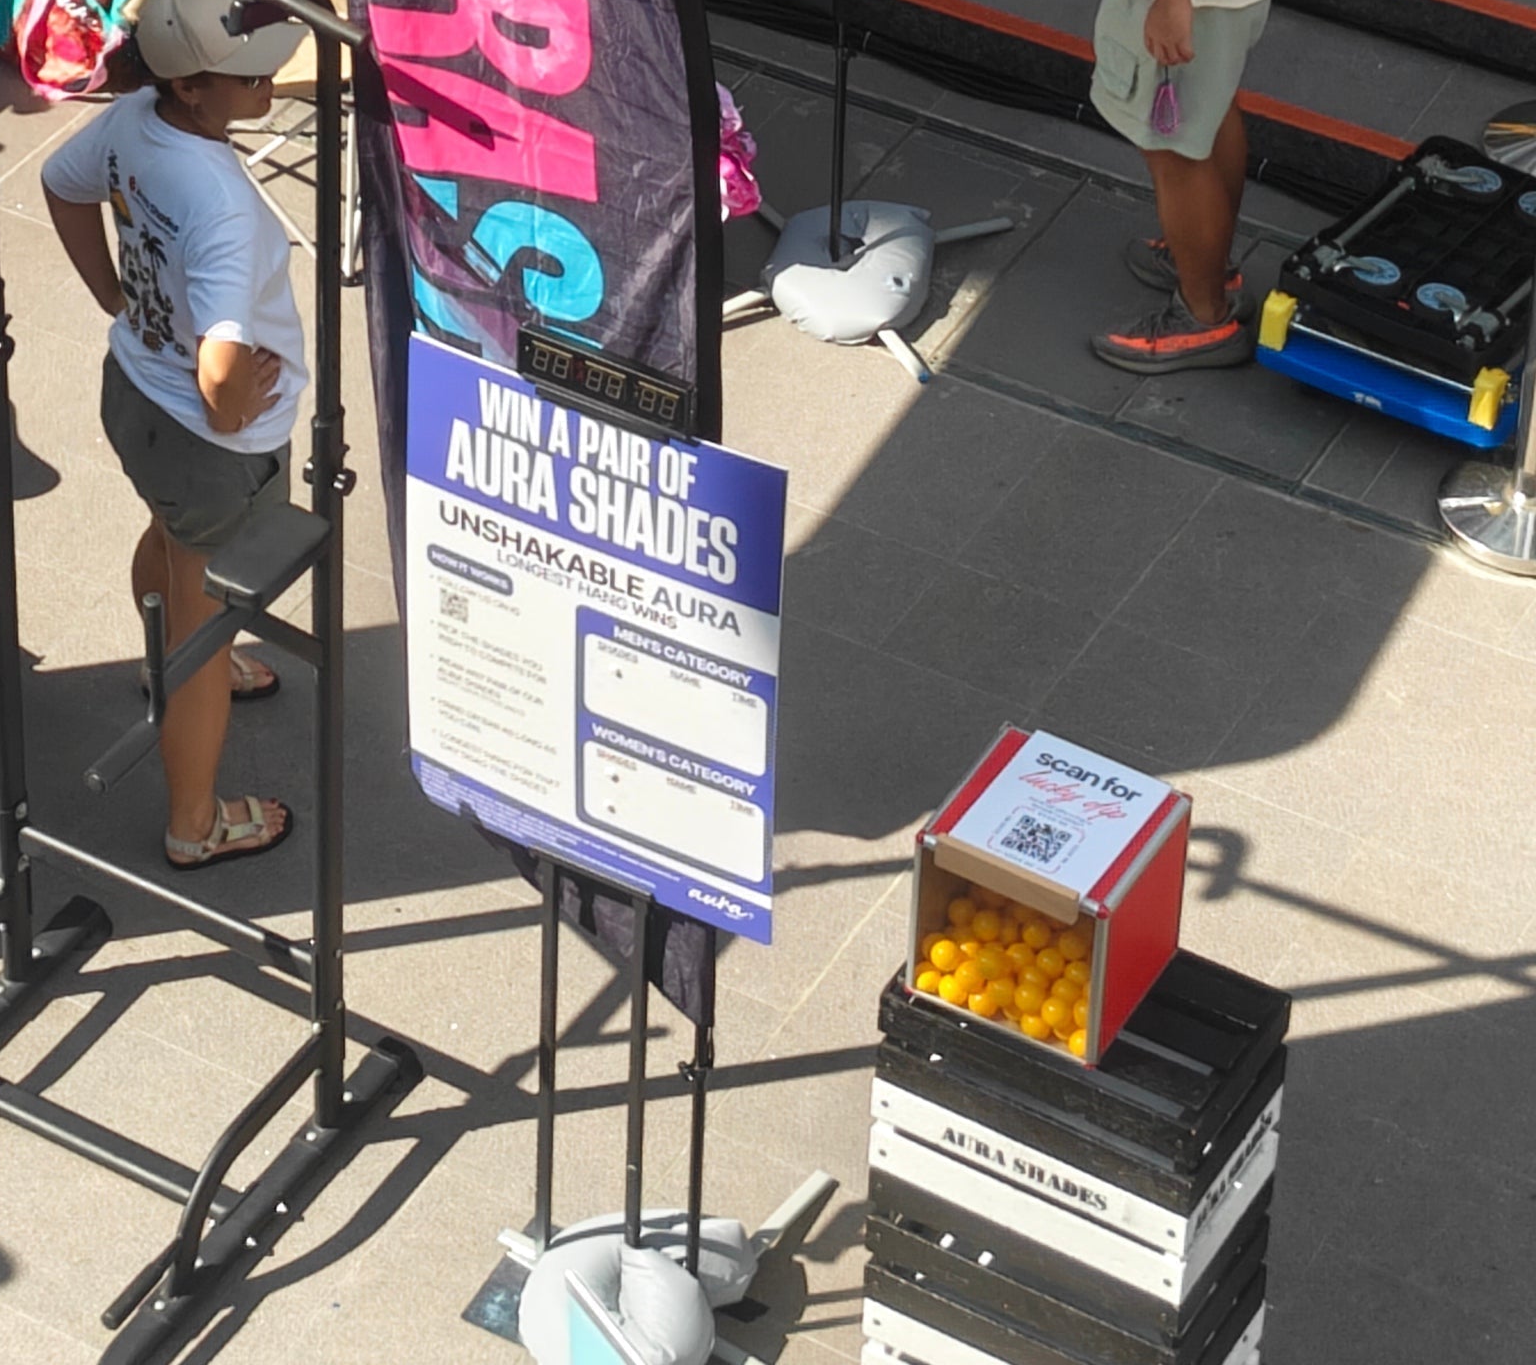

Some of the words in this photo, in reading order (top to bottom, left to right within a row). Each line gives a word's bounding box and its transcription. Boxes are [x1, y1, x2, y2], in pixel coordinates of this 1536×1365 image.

[478, 378, 543, 447] WIN
[548, 406, 571, 458] A
[579, 417, 651, 487] PAIR
[658, 443, 699, 501] OF
[445, 418, 559, 522] AURA
[568, 467, 739, 586] SHADES
[439, 500, 644, 600] UNSHAKABLE
[651, 585, 742, 638] AURA
[496, 548, 574, 591] LONGEST
[578, 578, 628, 611] HANG
[631, 599, 678, 630] WINS
[612, 624, 661, 659] MEN'S
[664, 644, 754, 689] CATEGORY
[591, 722, 667, 767] WOMEN'S
[669, 750, 758, 798] CATEGORY
[1017, 769, 1085, 806] lucky
[1081, 798, 1128, 824] dip
[1035, 750, 1100, 788] scan
[1100, 775, 1142, 803] for
[686, 886, 748, 920] aura
[940, 1125, 1007, 1167] AURA
[1011, 1157, 1110, 1213] SHADES
